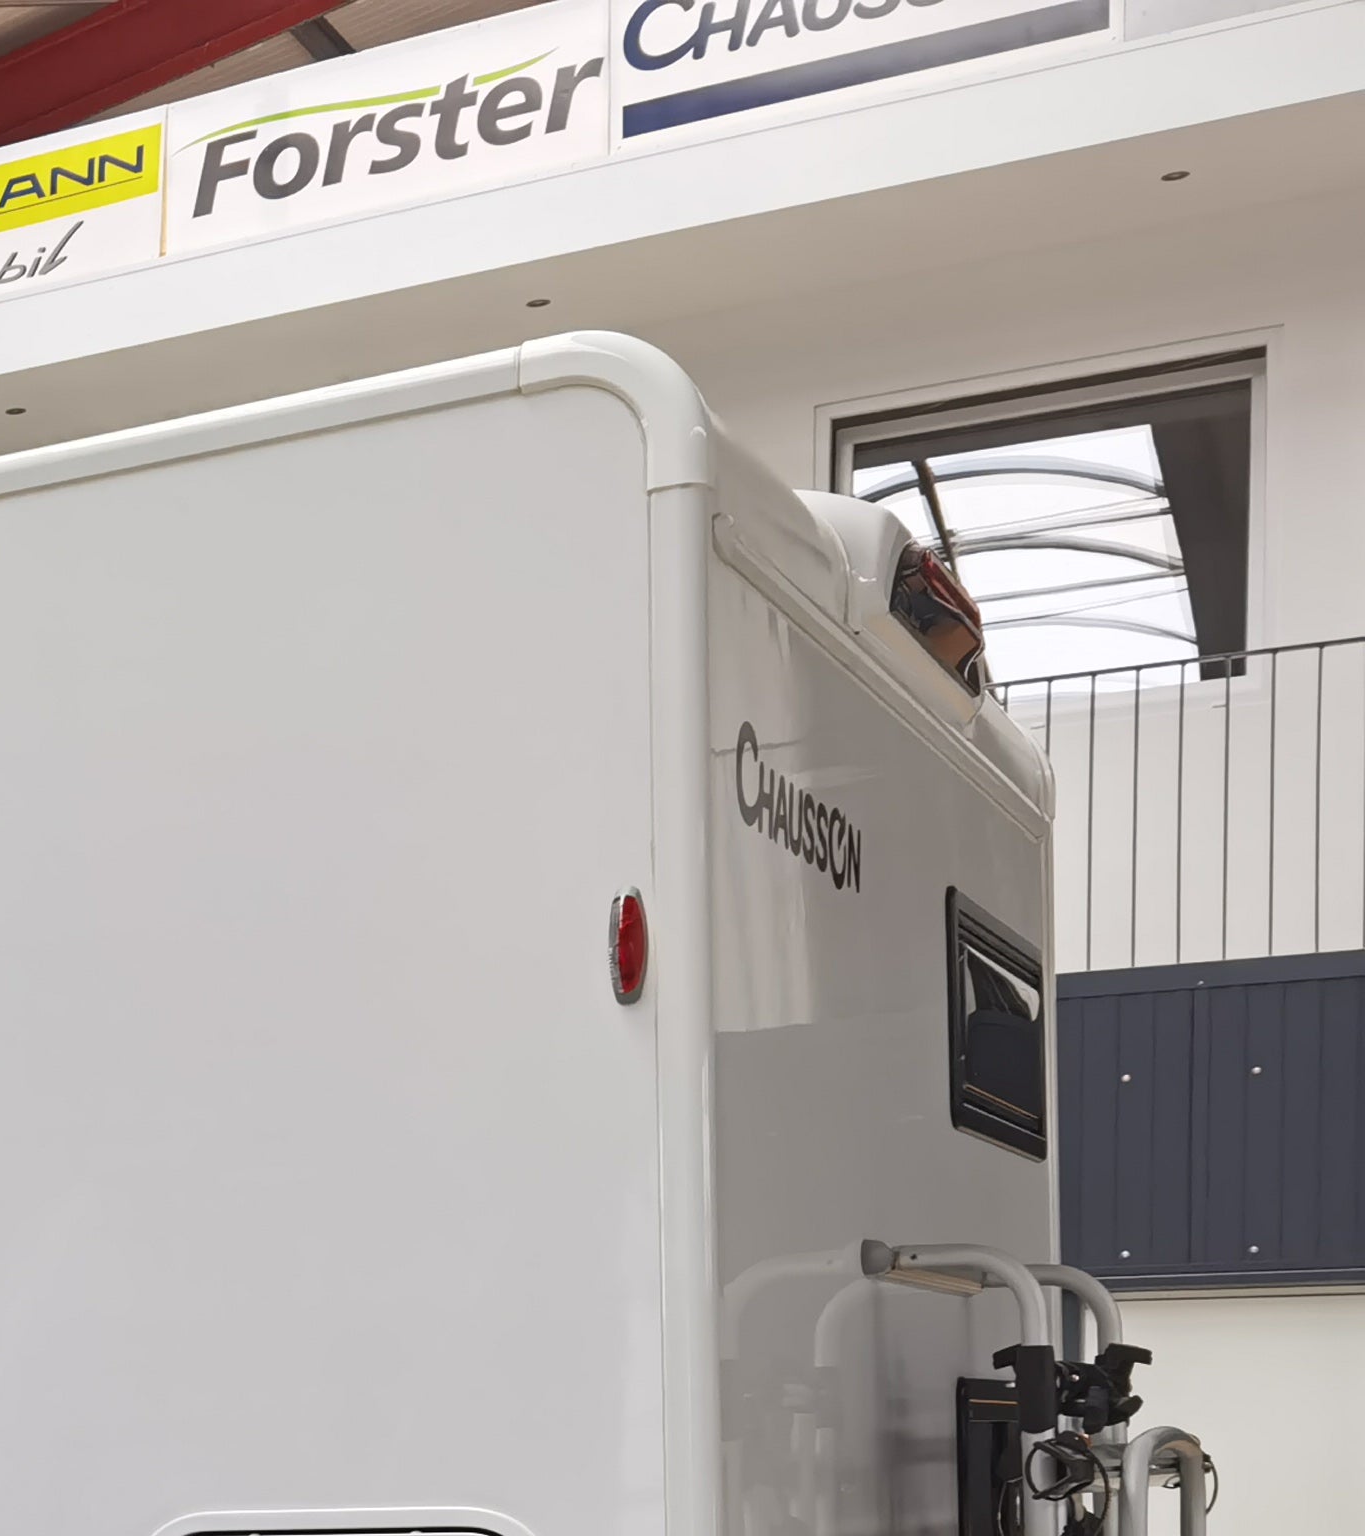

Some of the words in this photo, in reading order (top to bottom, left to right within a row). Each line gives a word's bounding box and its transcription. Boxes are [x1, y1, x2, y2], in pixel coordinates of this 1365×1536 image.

[623, 0, 949, 70] CHAU
[191, 56, 604, 218] Forster
[736, 720, 861, 894] CHAUSSON
